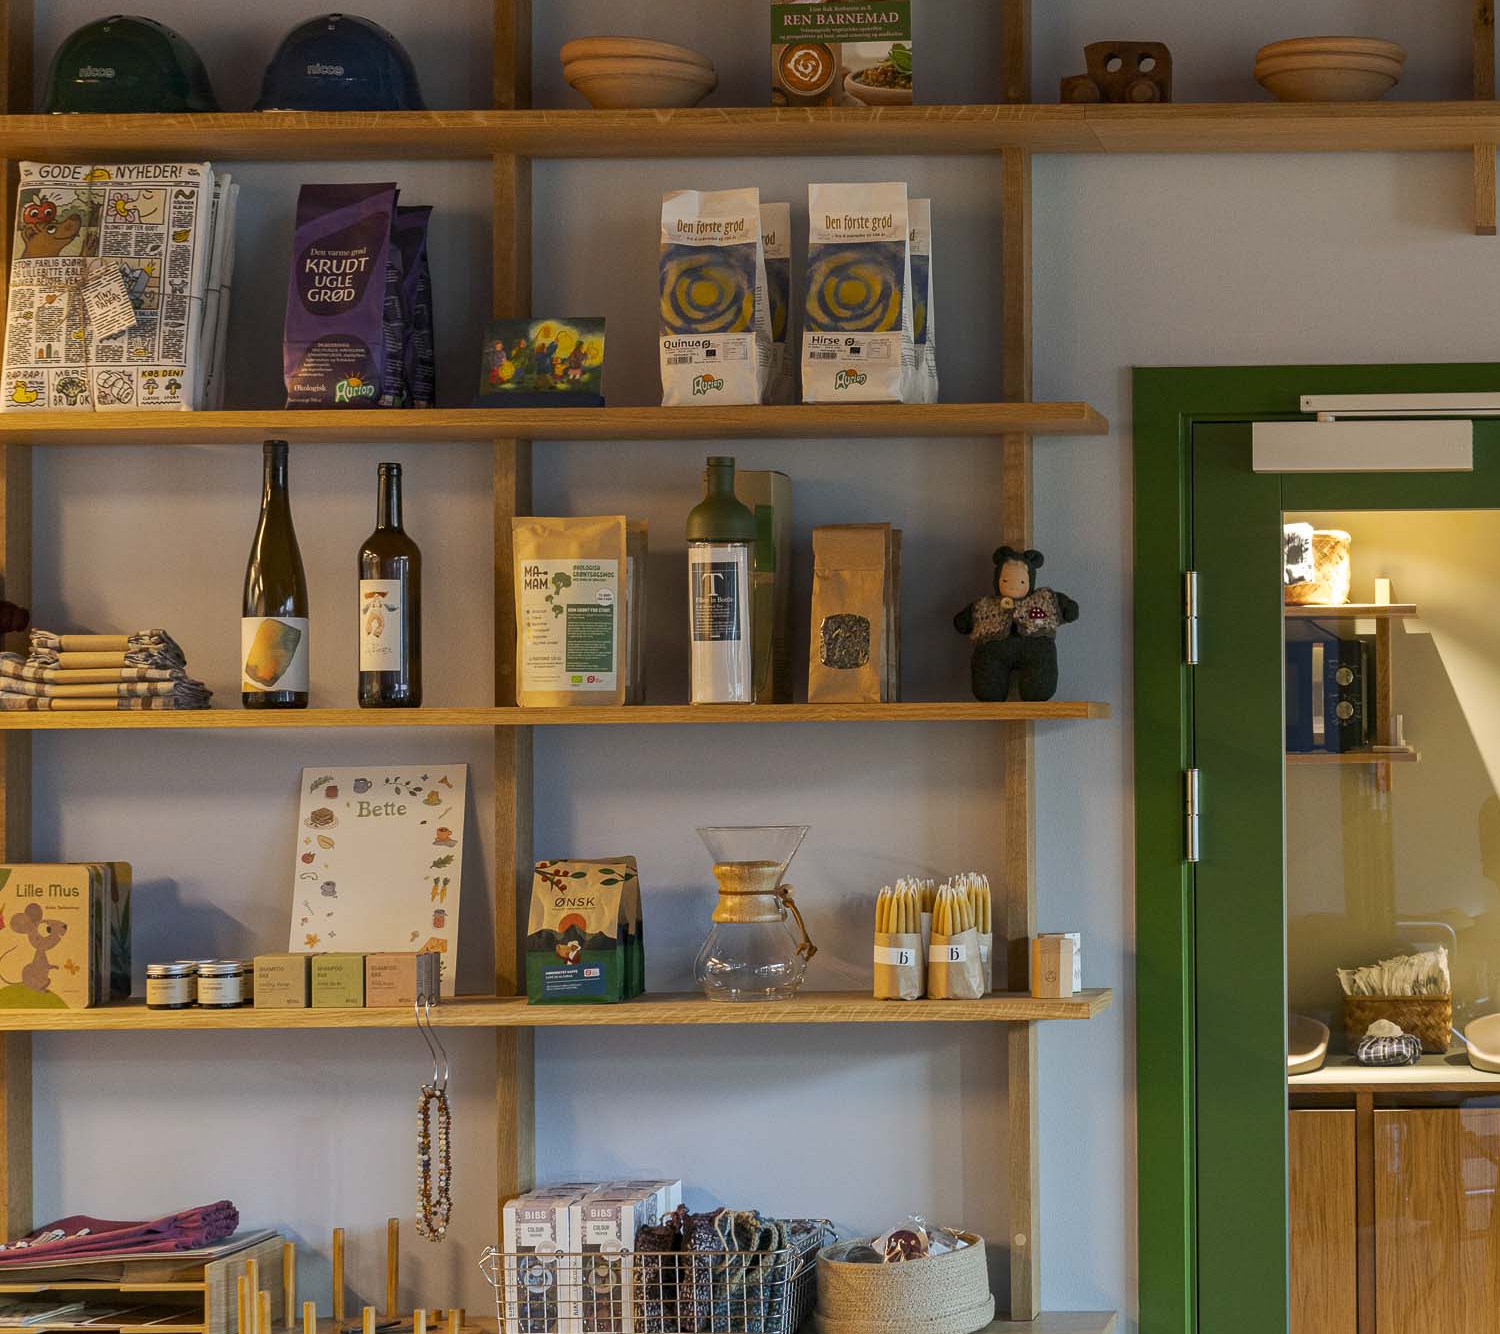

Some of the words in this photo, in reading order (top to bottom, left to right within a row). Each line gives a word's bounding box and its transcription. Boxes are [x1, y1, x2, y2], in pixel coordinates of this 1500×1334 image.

[783, 14, 812, 26] REN
[817, 12, 899, 25] BARNEMAD
[39, 166, 82, 180] GODE
[115, 166, 183, 180] NYHEDER!
[677, 219, 693, 232] Den
[696, 220, 722, 234] første
[724, 218, 744, 235] grød
[825, 215, 841, 229] Den
[844, 215, 869, 230] første
[872, 214, 892, 231] grød
[761, 232, 776, 245] rød
[311, 248, 326, 256] Den
[305, 257, 369, 274] KRUDT
[315, 275, 353, 287] UGLE
[95, 288, 113, 301] TINY
[307, 288, 355, 302] GRØD
[95, 294, 121, 309] PAPERS
[664, 339, 701, 348] Quinua
[812, 336, 840, 345] Hirse
[6, 370, 21, 378] RAP
[23, 370, 44, 378] RAP!
[141, 370, 158, 378] KØB
[834, 370, 867, 390] Aurion
[294, 384, 326, 392] Økologisk
[335, 378, 375, 403] Aurion
[693, 375, 724, 395] Aurion
[524, 578, 549, 590] MAM
[702, 573, 724, 596] T
[357, 801, 407, 818] Bette
[16, 884, 43, 897] Lille
[49, 884, 80, 897] Mus
[555, 897, 595, 907] ØNSK
[525, 1211, 546, 1219] BIBS
[591, 1209, 612, 1217] BIBS
